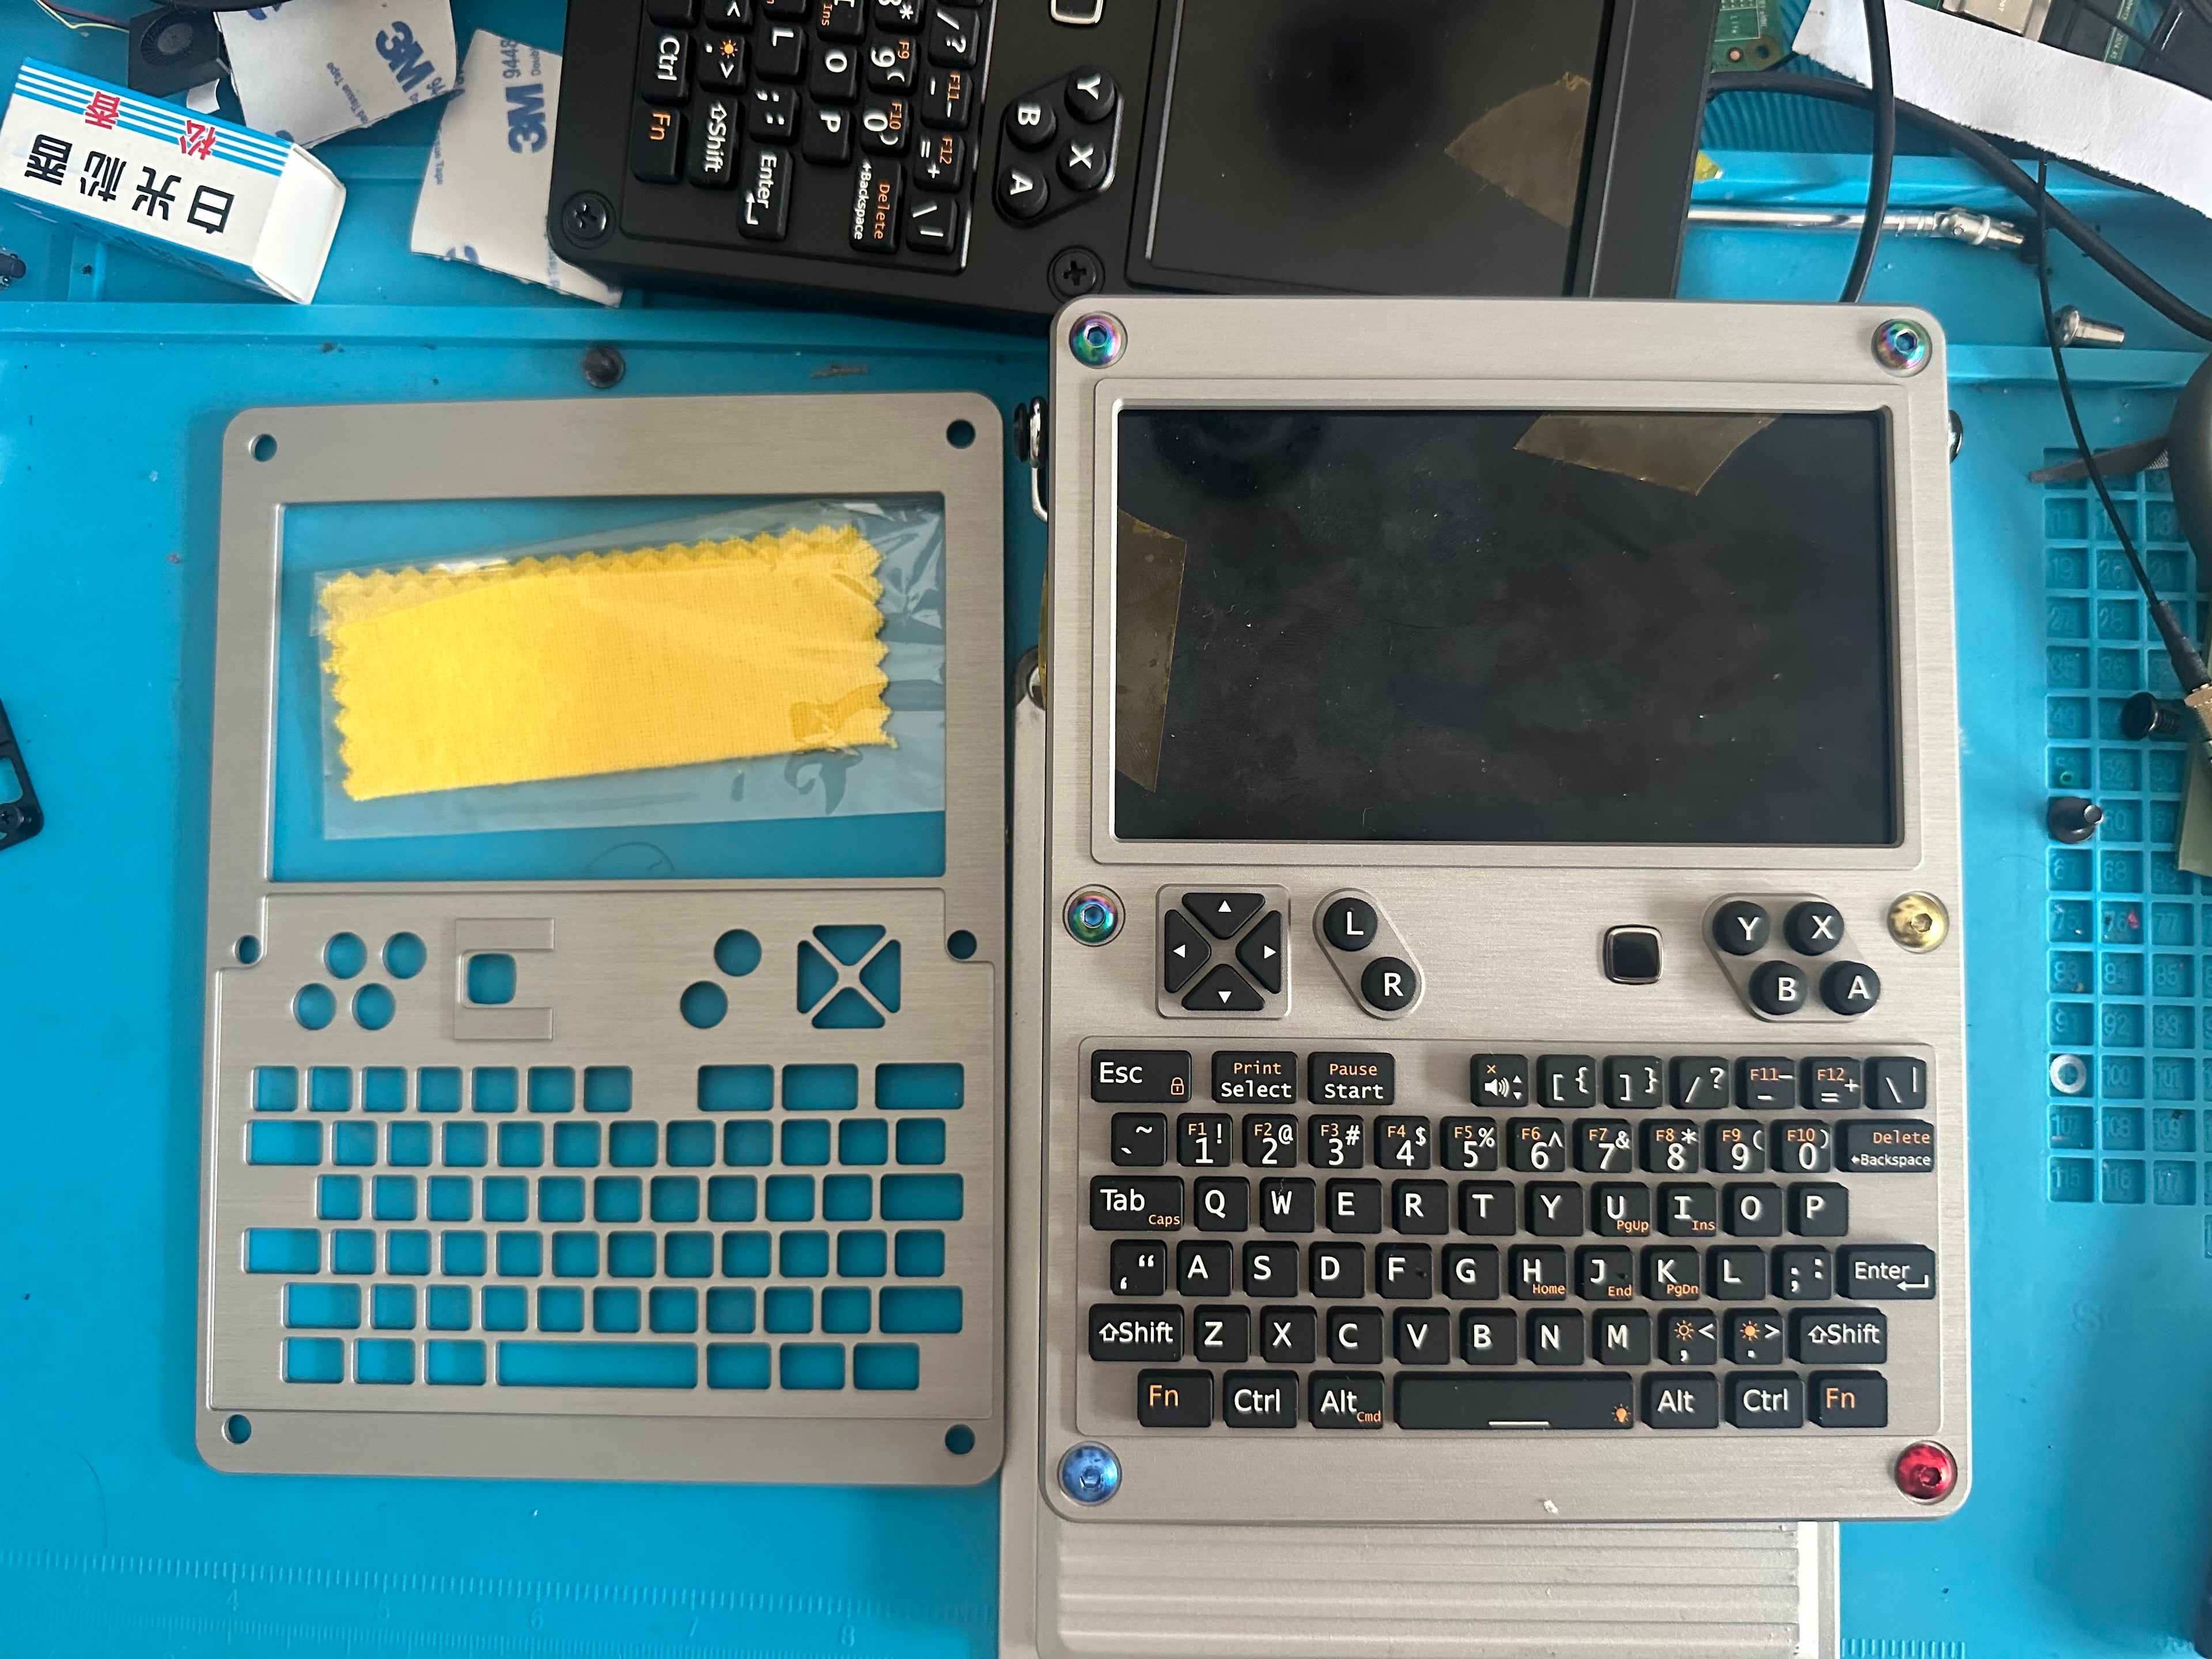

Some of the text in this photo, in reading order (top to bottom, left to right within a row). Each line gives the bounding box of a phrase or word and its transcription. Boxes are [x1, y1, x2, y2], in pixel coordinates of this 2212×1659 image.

[821, 4, 832, 26] Ins
[773, 30, 794, 46] L
[897, 40, 910, 59] F9
[376, 21, 435, 93] 3M
[658, 37, 680, 80] Ctrl
[825, 52, 847, 73] O
[871, 50, 895, 67] 9
[327, 62, 343, 86] Tape
[948, 74, 960, 99] F11
[1077, 78, 1101, 100] Y
[85, 91, 217, 160] 松香
[506, 84, 547, 153] 3M
[650, 113, 671, 141] Fn
[821, 115, 840, 132] P
[864, 113, 888, 131] 0
[889, 103, 902, 129] F10
[1018, 108, 1041, 126] B
[705, 122, 726, 172] Shift
[940, 138, 953, 164] F12
[1070, 145, 1093, 169] X
[25, 135, 234, 233] 白光松香
[757, 156, 777, 209] Enter
[1010, 174, 1033, 195] A
[854, 172, 872, 239] Backspace
[874, 184, 890, 239] Delete
[1347, 911, 1363, 935] L
[1737, 916, 1759, 940] Y
[1812, 915, 1833, 939] X
[1384, 972, 1404, 997] R
[2155, 963, 2177, 986] 85
[1778, 977, 1796, 1001] B
[1847, 976, 1870, 999] A
[2104, 1013, 2130, 1036] 92
[2155, 1014, 2178, 1037] 93
[1100, 1062, 1143, 1084] Esc
[1234, 1063, 1281, 1075] Print
[1330, 1063, 1377, 1076] Pause
[1710, 1067, 1724, 1089] ?
[1751, 1069, 1778, 1081] F11
[1817, 1069, 1843, 1081] F12
[1221, 1081, 1292, 1098] Select
[1325, 1084, 1384, 1100] Start
[1188, 1123, 1206, 1135] F1
[1255, 1123, 1272, 1136] F2
[1278, 1124, 1293, 1145] @
[1321, 1124, 1339, 1137] F3
[1346, 1126, 1360, 1146] #
[1388, 1125, 1406, 1138] F4
[1416, 1126, 1426, 1146] $
[1455, 1126, 1472, 1139] F5
[1478, 1127, 1495, 1147] %
[1522, 1127, 1540, 1140] F6
[1589, 1128, 1607, 1141] F7
[1615, 1130, 1630, 1149] &
[1656, 1130, 1673, 1141] F8
[1722, 1130, 1740, 1142] F9
[1787, 1129, 1815, 1142] F10
[1873, 1131, 1930, 1144] Delete
[1195, 1137, 1213, 1164] 1
[1262, 1138, 1278, 1164] 2
[1328, 1139, 1344, 1165] 3
[1396, 1140, 1414, 1166] 4
[1464, 1141, 1478, 1168] 5
[1531, 1142, 1548, 1169] 6
[1598, 1143, 1614, 1169] 7
[1667, 1143, 1684, 1171] 8
[1732, 1143, 1748, 1171] 9
[1798, 1143, 1816, 1171] 0
[1861, 1154, 1931, 1168] Backspace
[1100, 1188, 1145, 1211] Tab
[1205, 1190, 1226, 1218] Q
[1271, 1191, 1292, 1214] W
[1338, 1192, 1354, 1215] E
[1406, 1194, 1424, 1217] R
[1472, 1194, 1494, 1218] T
[1540, 1195, 1560, 1219] Y
[1607, 1196, 1624, 1219] U
[1674, 1196, 1691, 1219] I
[1741, 1196, 1761, 1220] O
[1806, 1196, 1824, 1219] P
[1149, 1214, 1180, 1227] Caps
[1617, 1220, 1649, 1232] PgUp
[1692, 1221, 1715, 1230] Ins
[1188, 1255, 1208, 1279] A
[1253, 1256, 1271, 1280] S
[1321, 1256, 1340, 1280] D
[1388, 1257, 1405, 1282] F
[1456, 1259, 1476, 1283] G
[1523, 1259, 1541, 1283] H
[1590, 1259, 1604, 1283] J
[1658, 1259, 1676, 1283] K
[1724, 1260, 1741, 1283] L
[1855, 1262, 1910, 1279] Enter
[1533, 1284, 1565, 1294] Home
[1608, 1286, 1632, 1296] End
[1666, 1285, 1698, 1297] PgDn
[1119, 1321, 1173, 1343] Shift
[1205, 1322, 1224, 1346] Z
[1272, 1322, 1291, 1348] X
[1339, 1324, 1358, 1349] C
[1407, 1324, 1427, 1349] V
[1474, 1325, 1491, 1349] B
[1541, 1325, 1559, 1350] N
[1608, 1325, 1627, 1349] M
[1827, 1324, 1880, 1344] Shift
[1149, 1385, 1178, 1407] Fn
[1234, 1389, 1281, 1413] Ctrl
[1321, 1390, 1357, 1414] Alt
[1657, 1390, 1695, 1413] Alt
[1744, 1389, 1789, 1412] Ctrl
[1826, 1388, 1855, 1408] Fn
[1357, 1411, 1381, 1422] Cmd
